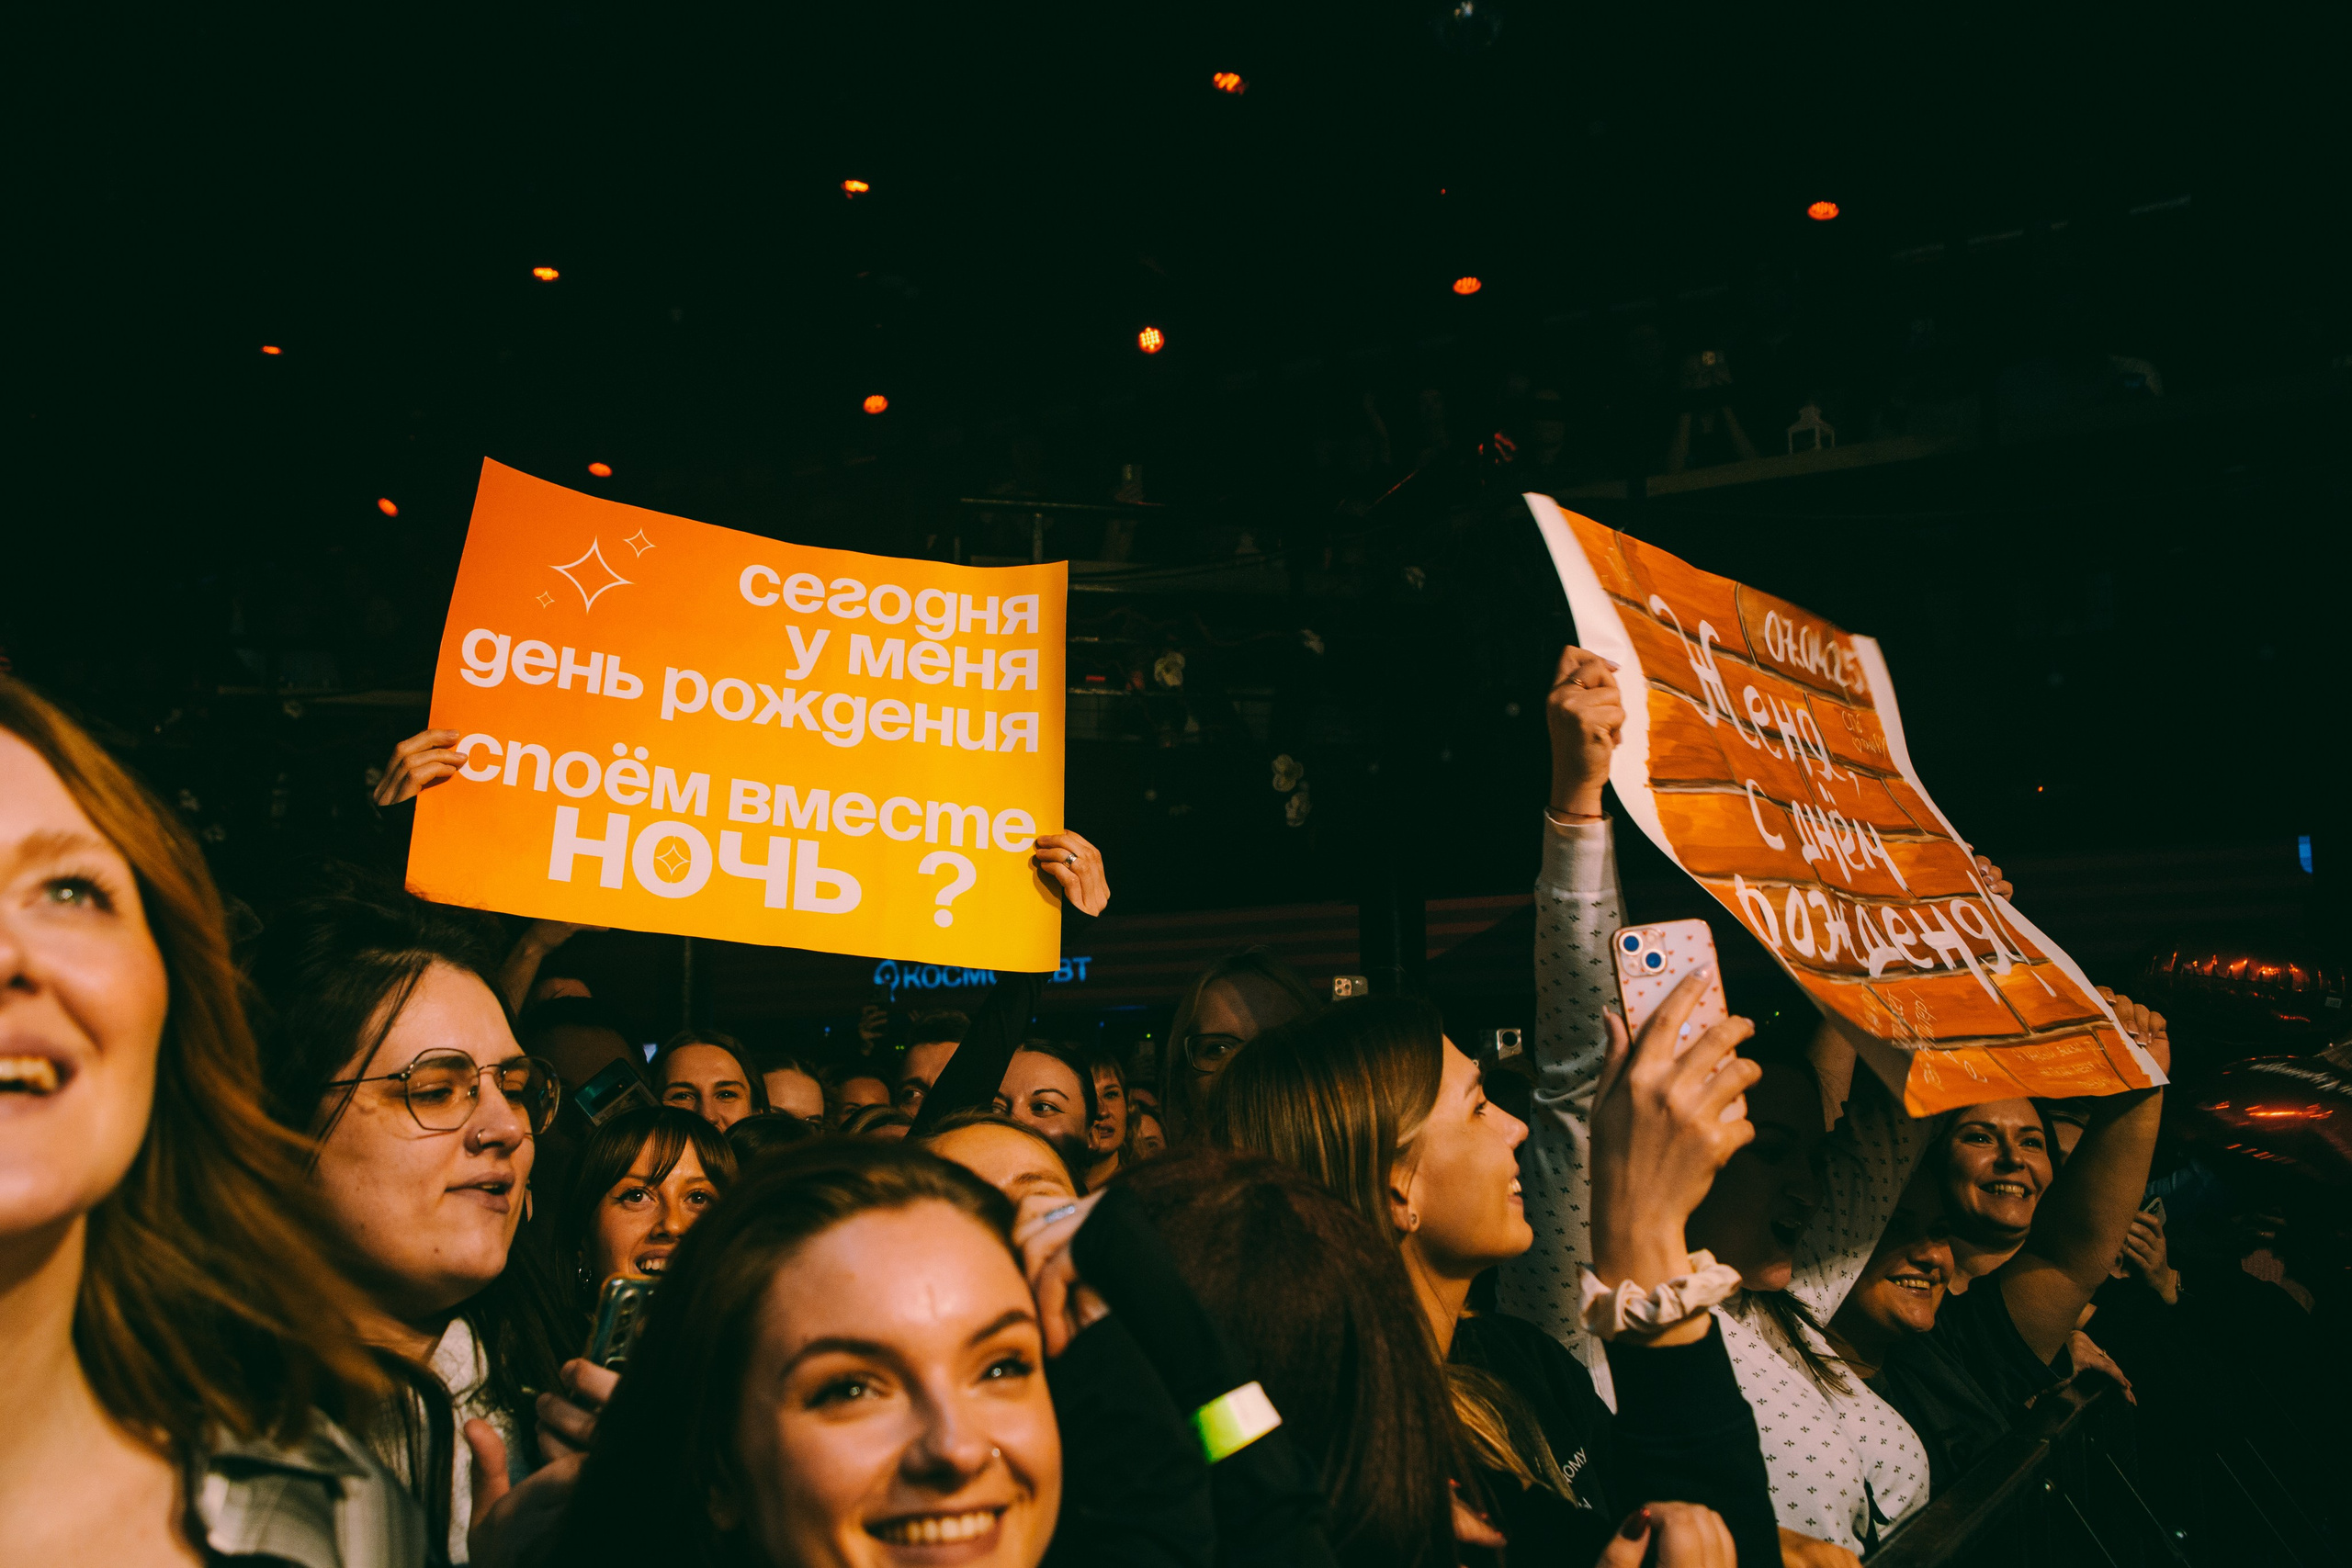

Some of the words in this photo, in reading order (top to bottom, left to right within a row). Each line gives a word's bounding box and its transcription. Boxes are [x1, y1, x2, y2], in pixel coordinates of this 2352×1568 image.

[739, 564, 1040, 639] сегодня
[784, 625, 831, 681] у
[849, 632, 1040, 692] меня
[460, 627, 644, 700] день
[660, 666, 1040, 754] рождения
[457, 732, 711, 818] споём
[729, 778, 1037, 854] вместе
[548, 806, 863, 915] НОЧЬ
[918, 851, 977, 928] ?
